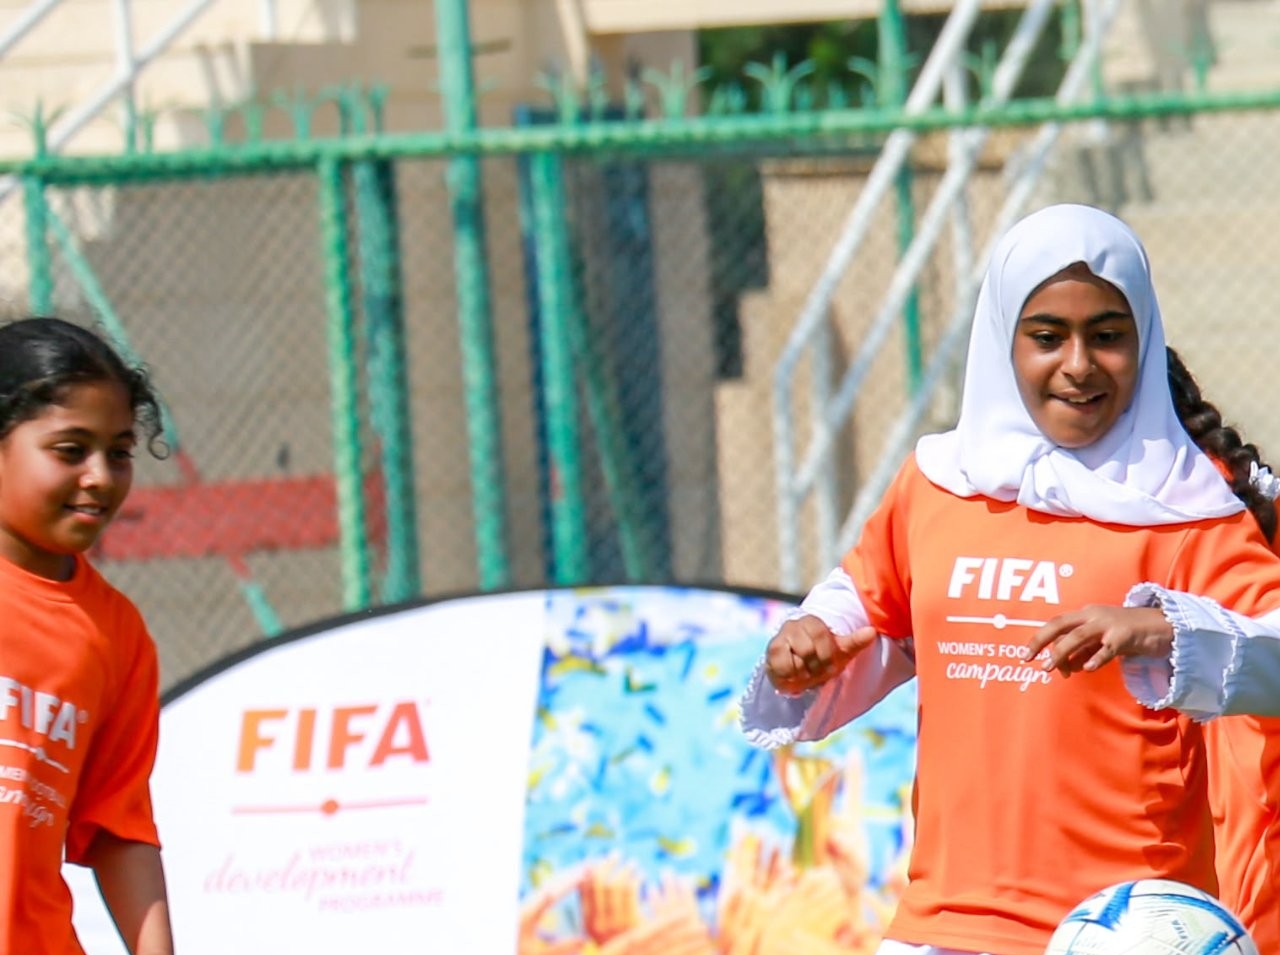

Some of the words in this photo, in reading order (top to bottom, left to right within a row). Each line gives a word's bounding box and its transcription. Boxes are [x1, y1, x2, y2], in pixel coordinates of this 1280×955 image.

[947, 556, 1060, 604] FIFA
[937, 641, 995, 657] WOMEN'S
[946, 660, 1053, 692] campaign
[236, 700, 430, 773] FIFA
[202, 849, 416, 900] development
